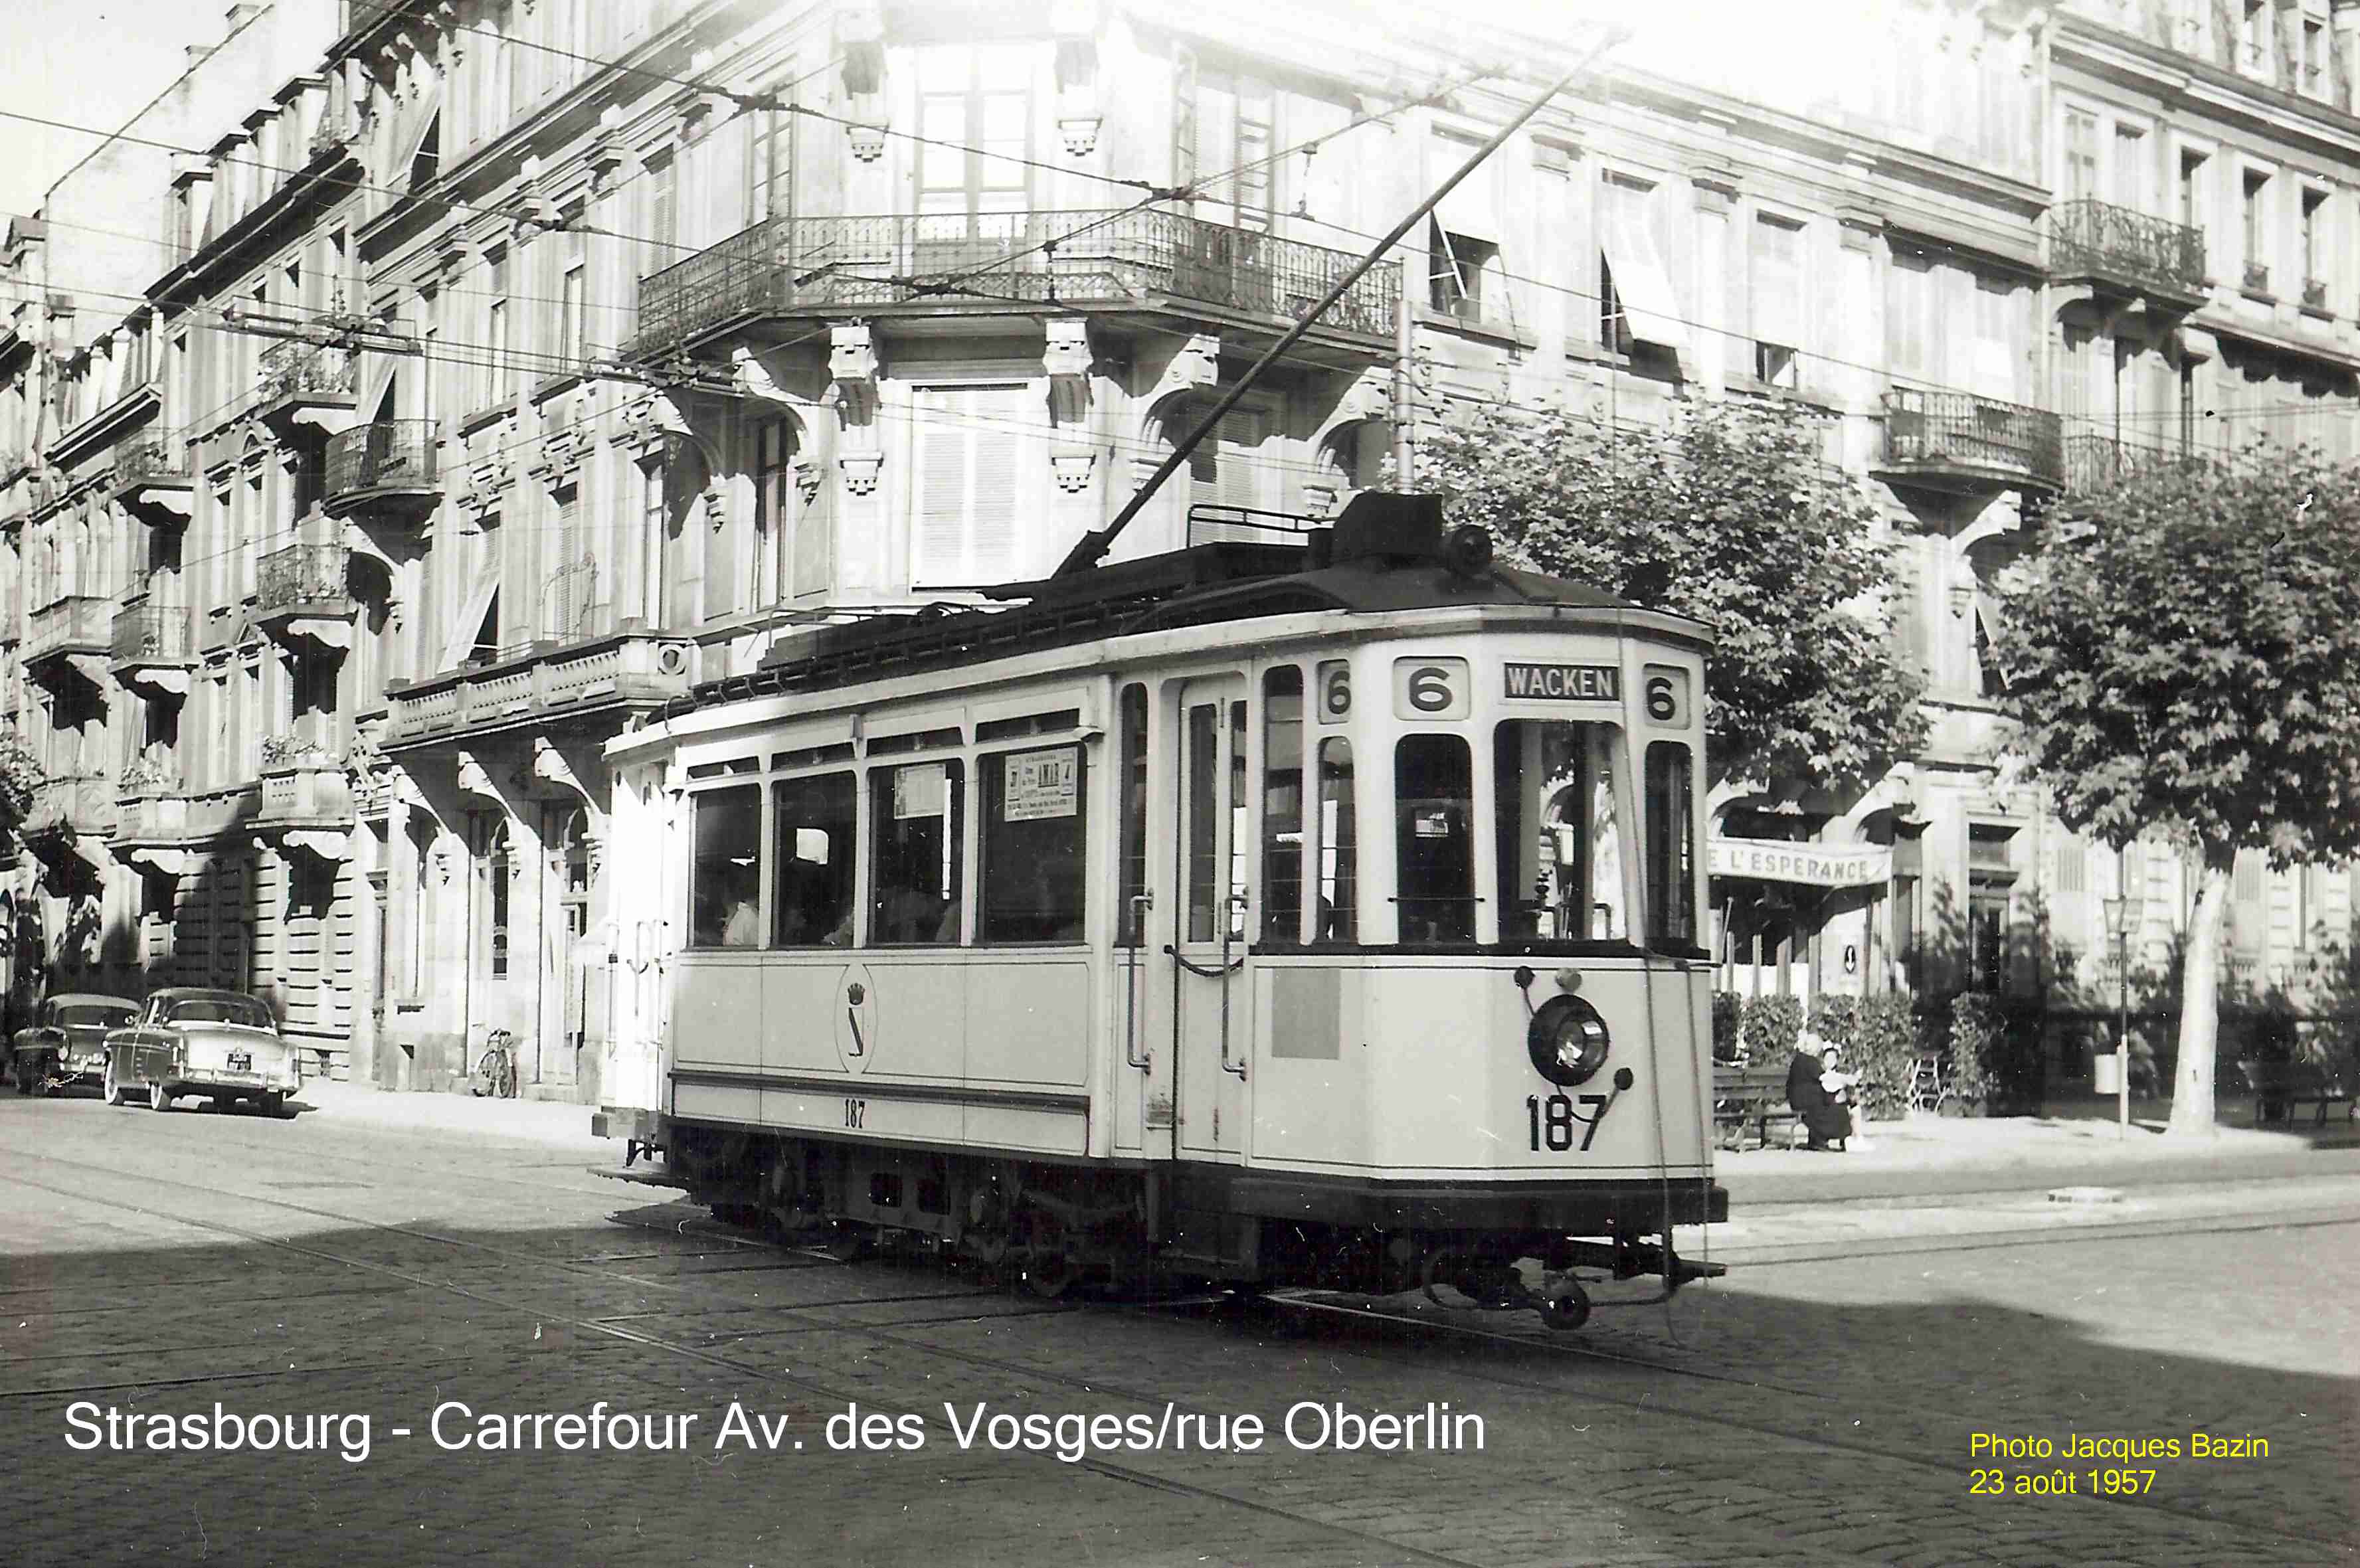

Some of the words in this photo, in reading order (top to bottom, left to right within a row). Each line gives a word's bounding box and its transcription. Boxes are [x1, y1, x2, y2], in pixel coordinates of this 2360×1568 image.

[1328, 670, 1352, 715] 6
[1409, 667, 1453, 712] 6
[1508, 667, 1613, 697] WACKEN
[1646, 677, 1677, 721] 6
[1730, 849, 1868, 881] L'ESPERANCE
[845, 1098, 865, 1129] 187
[1526, 1094, 1607, 1152] 187
